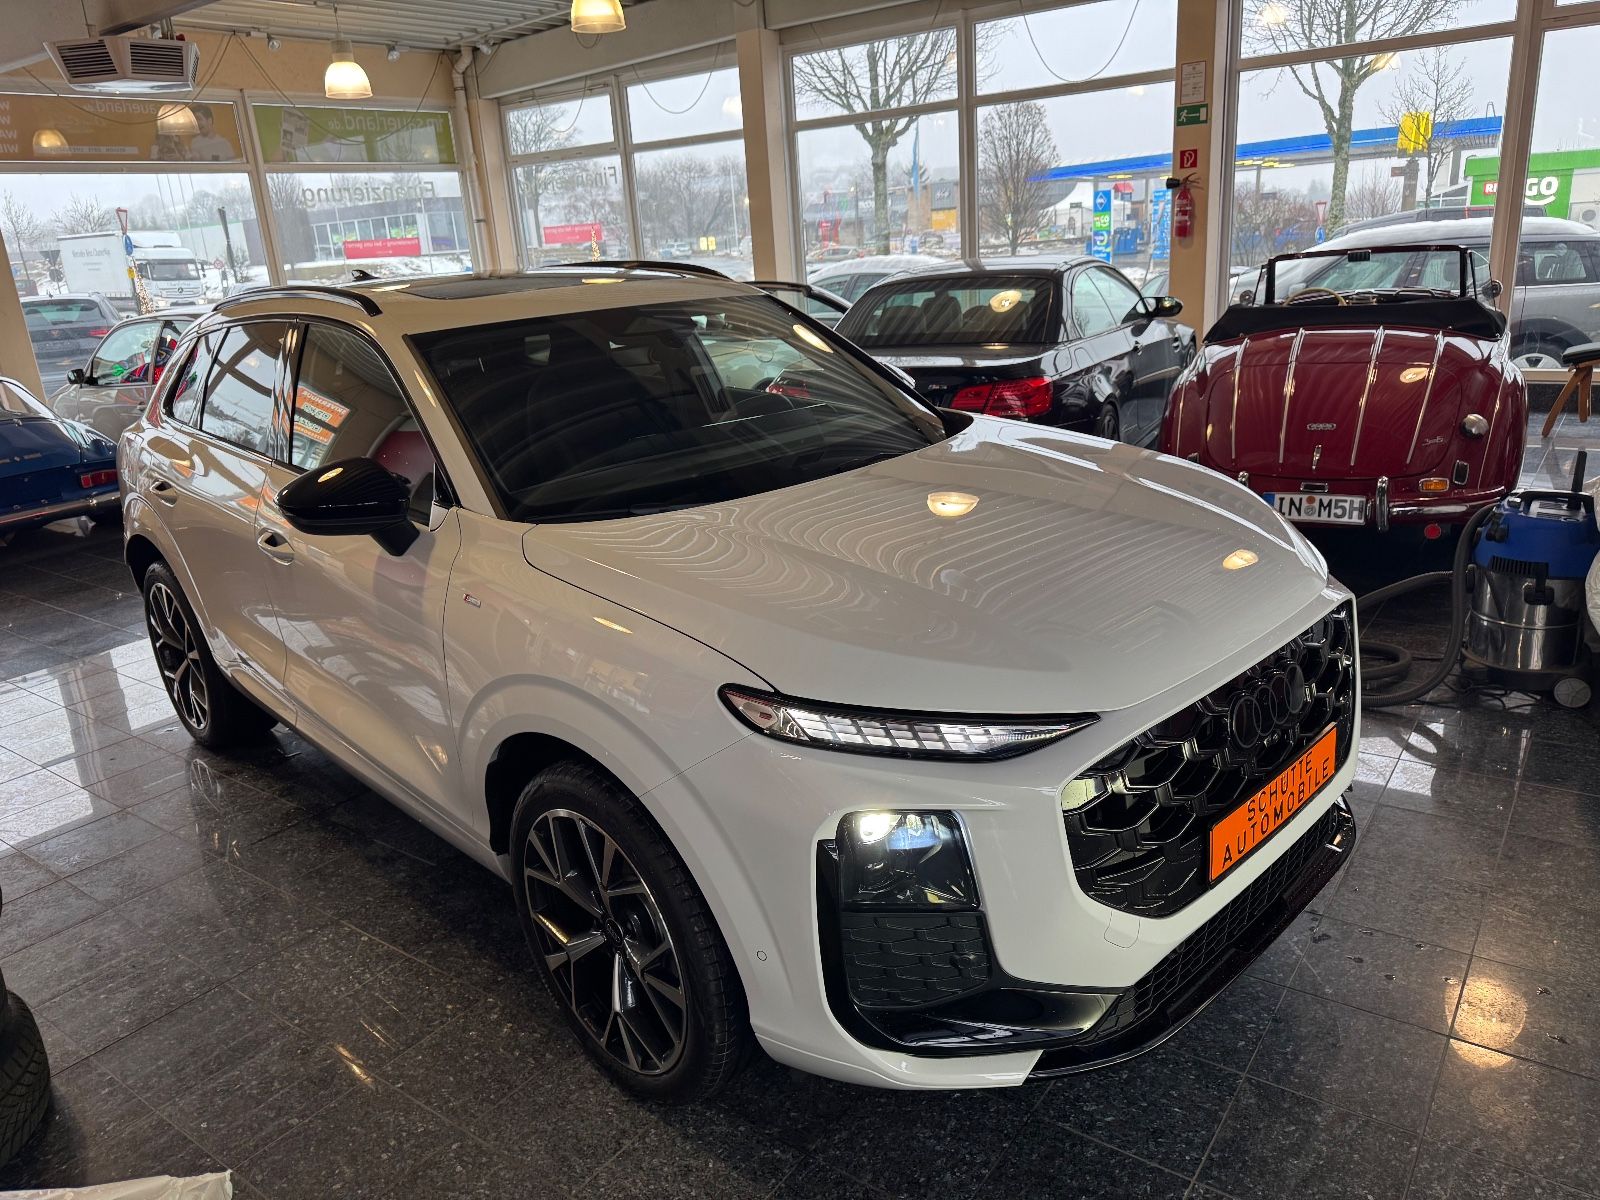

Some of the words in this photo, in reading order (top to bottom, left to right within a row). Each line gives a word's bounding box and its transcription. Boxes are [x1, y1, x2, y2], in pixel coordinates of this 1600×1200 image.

[1525, 176, 1559, 196] GO
[1278, 496, 1303, 517] IN
[1317, 498, 1365, 520] M5H
[1221, 757, 1330, 868] AUTOMOBILE
